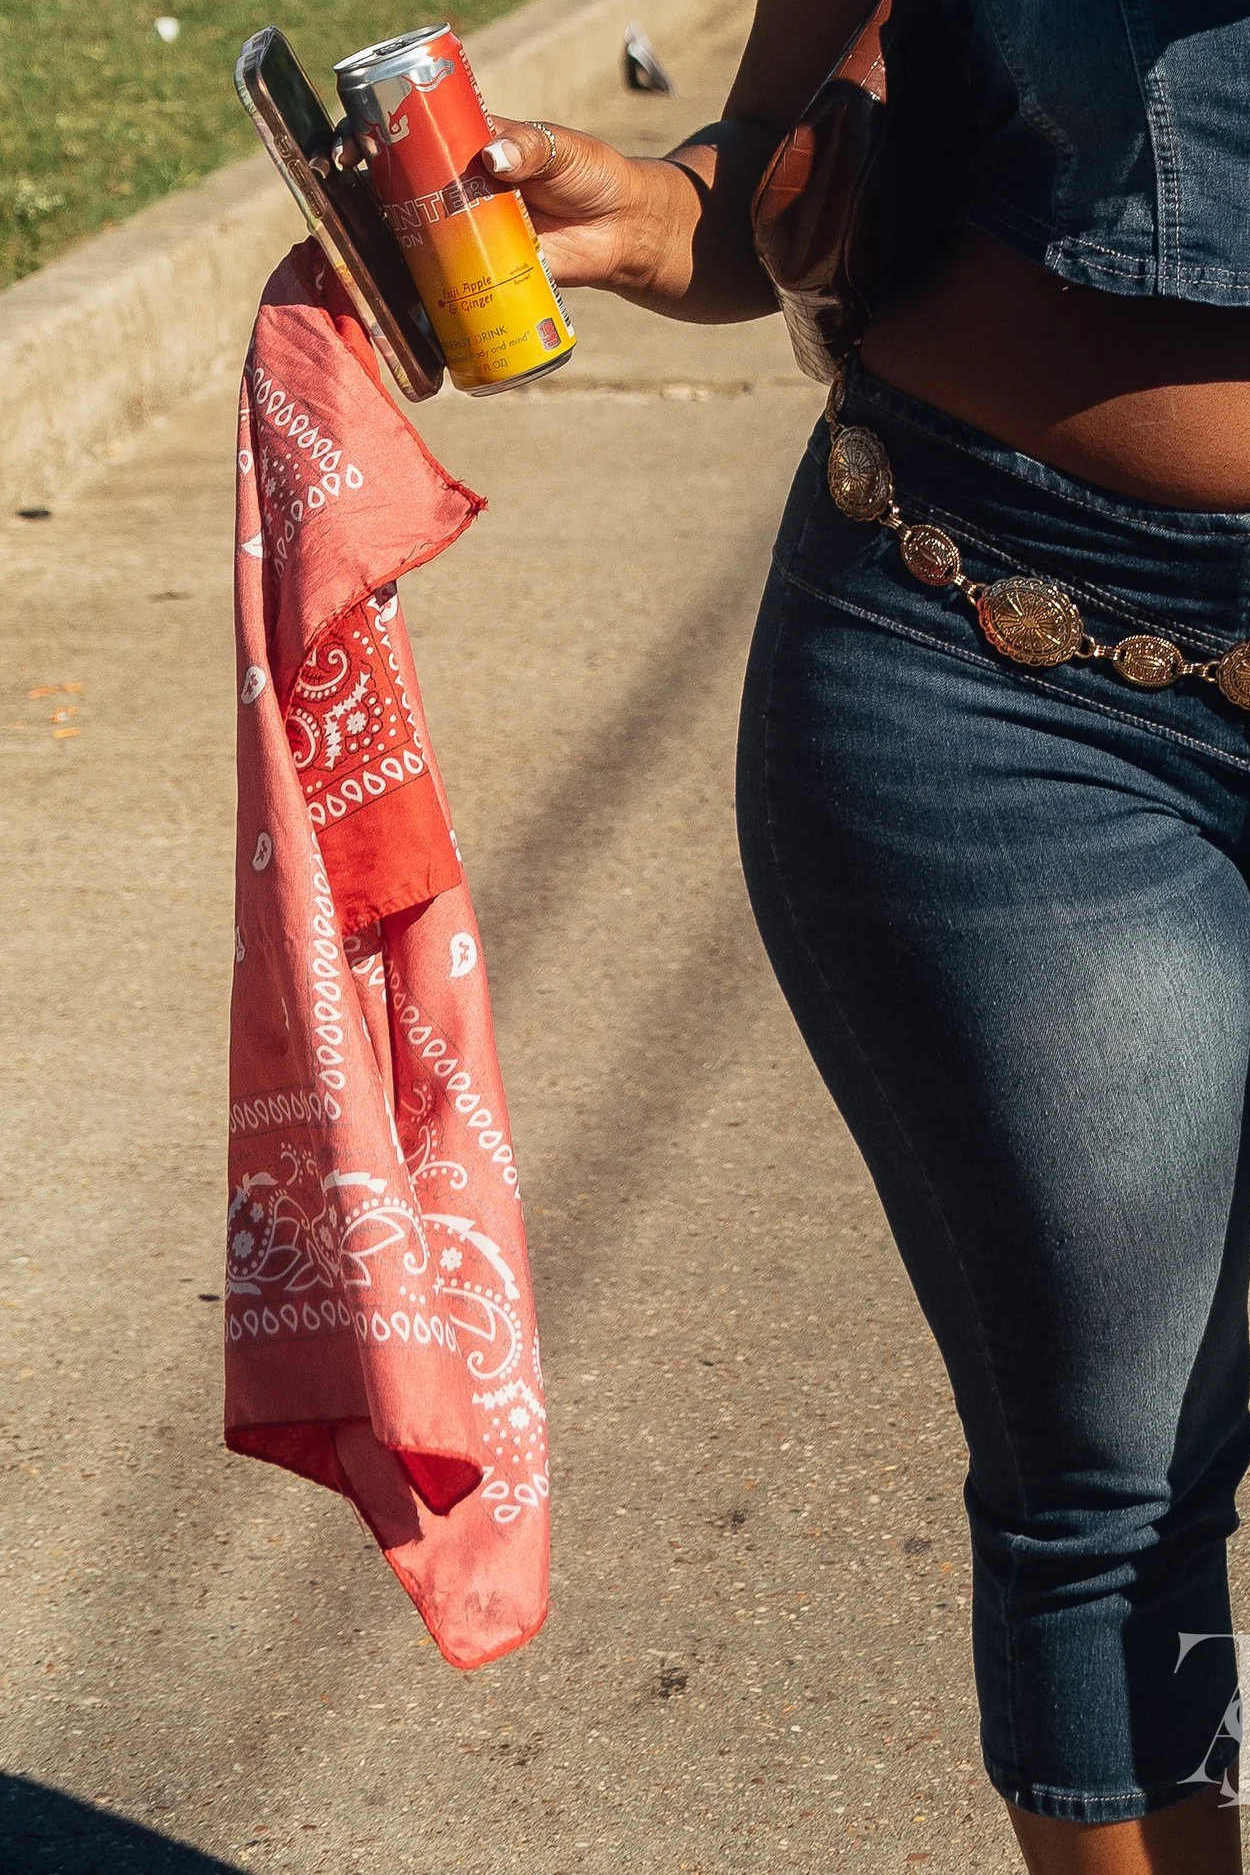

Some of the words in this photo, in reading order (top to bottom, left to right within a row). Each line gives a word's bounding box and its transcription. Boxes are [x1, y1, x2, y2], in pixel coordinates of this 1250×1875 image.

[381, 175, 495, 231] INTER
[442, 285, 460, 299] Fuji
[462, 275, 492, 294] Apple
[461, 293, 494, 312] Ginger
[474, 325, 508, 344] DRINK
[490, 340, 507, 354] and
